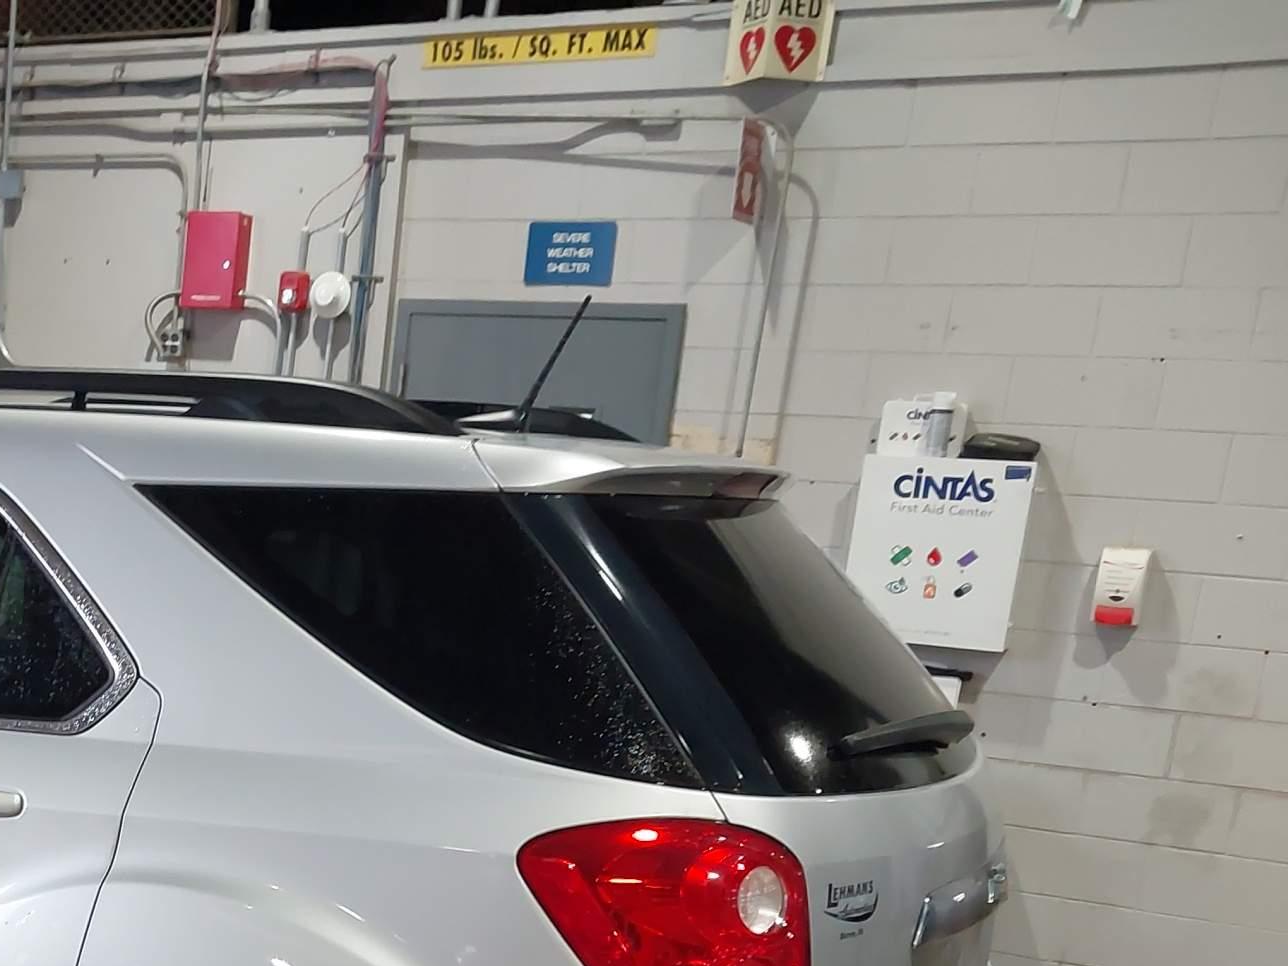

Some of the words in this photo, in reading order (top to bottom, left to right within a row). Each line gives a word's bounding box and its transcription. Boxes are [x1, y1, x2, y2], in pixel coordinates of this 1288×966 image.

[743, 0, 771, 24] AED
[778, 0, 822, 18] AED
[431, 38, 464, 63] 105
[471, 36, 504, 60] lbs.
[511, 33, 521, 59] /
[527, 34, 558, 59] SQ.
[567, 32, 594, 54] FT.
[602, 29, 650, 53] MAX
[552, 232, 591, 243] SEVERE
[547, 248, 593, 258] WEATHER
[547, 262, 590, 273] SHELTER
[890, 502, 919, 514] First
[921, 503, 945, 516] Aid
[948, 505, 994, 518] Center
